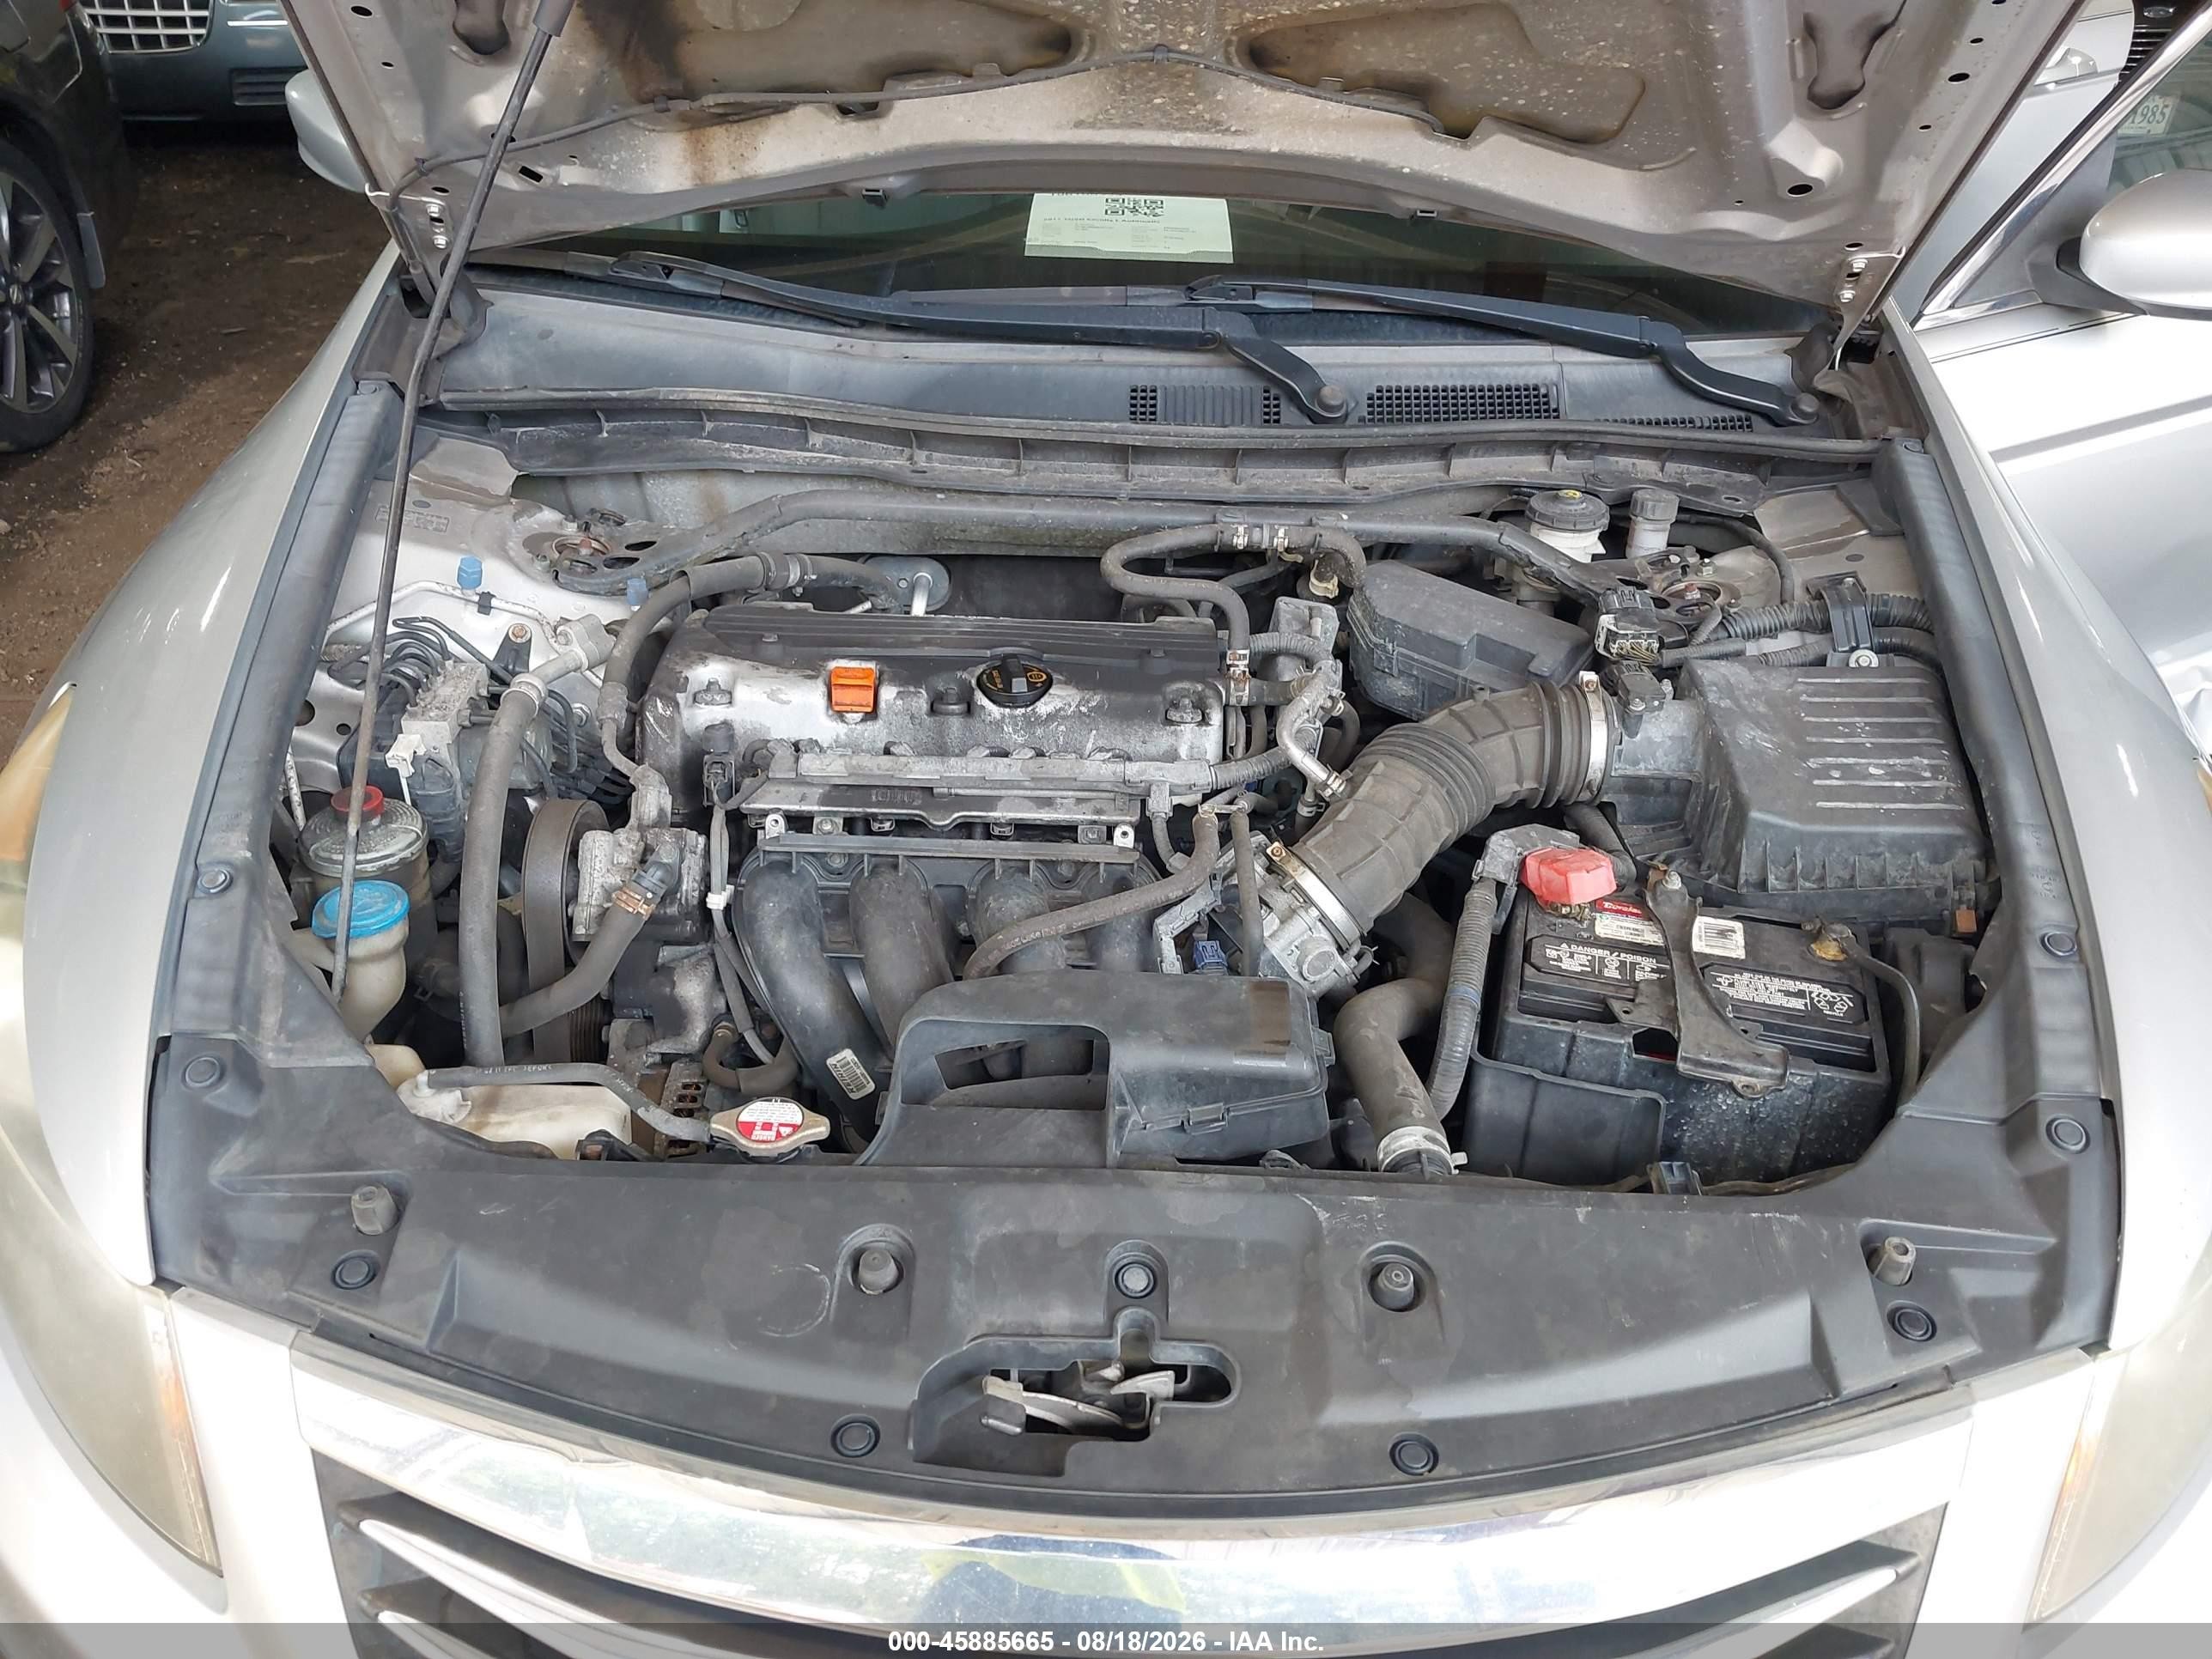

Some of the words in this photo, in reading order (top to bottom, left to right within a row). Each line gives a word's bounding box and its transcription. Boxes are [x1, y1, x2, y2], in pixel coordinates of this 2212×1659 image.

[1571, 944, 1610, 956] DANGER
[1620, 951, 1656, 963] POISON
[830, 1063, 856, 1093] KEIHIN
